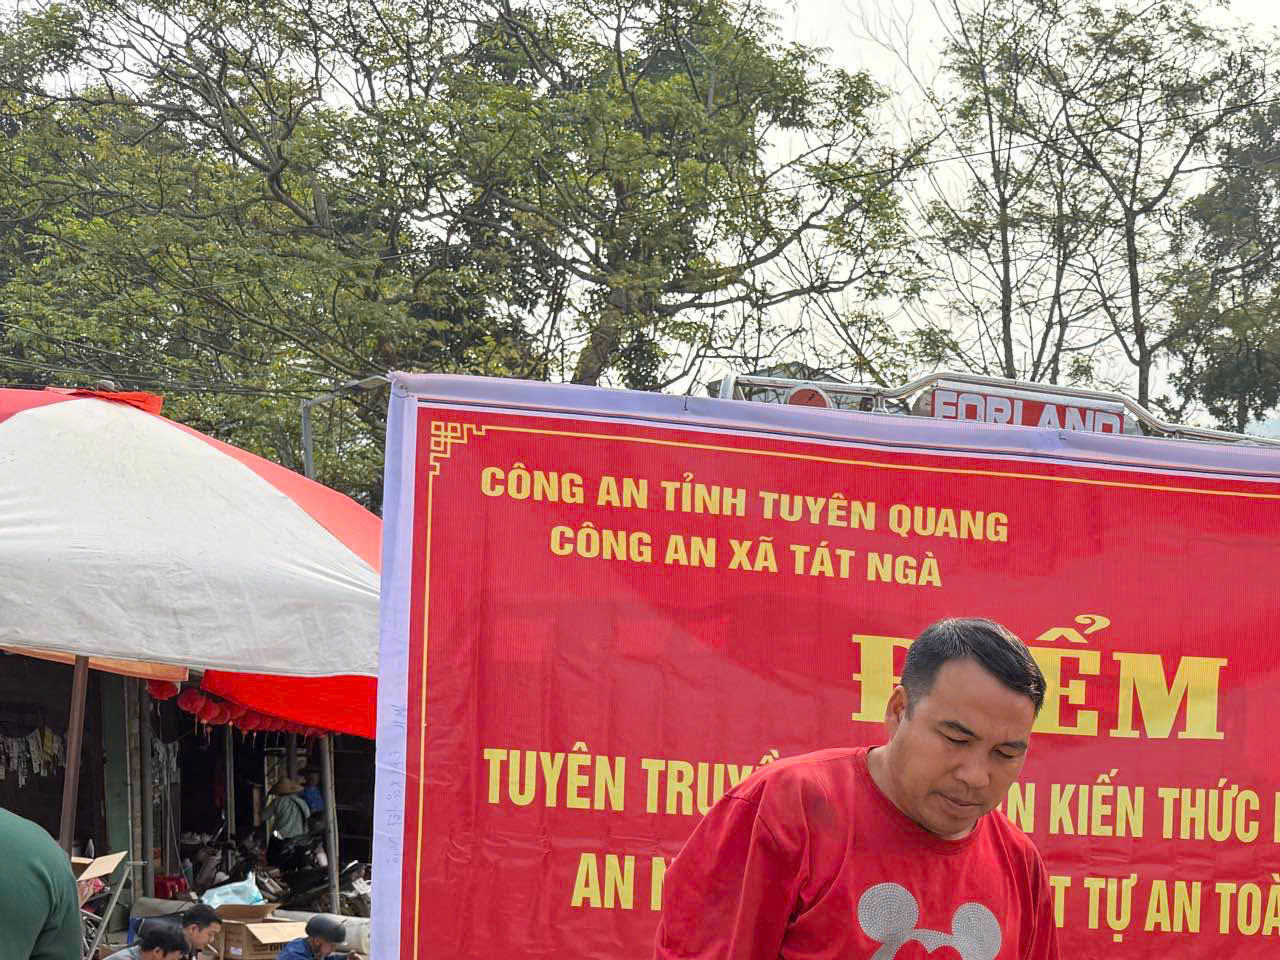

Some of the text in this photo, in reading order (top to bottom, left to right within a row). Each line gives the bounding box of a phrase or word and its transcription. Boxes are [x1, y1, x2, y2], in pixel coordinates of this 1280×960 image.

[933, 388, 1123, 434] FORLAND
[481, 463, 1010, 543] CÔNG AN TỈNH TUYÊN QUANG
[550, 521, 942, 587] CÔNG AN XÃ TÁT NGÀ
[483, 741, 626, 812] TUYÊN
[1049, 768, 1146, 838] KIẾN
[1157, 777, 1261, 844] THỨC
[570, 852, 636, 910] AN
[1083, 872, 1138, 943] TỰ
[1144, 879, 1202, 934] AN
